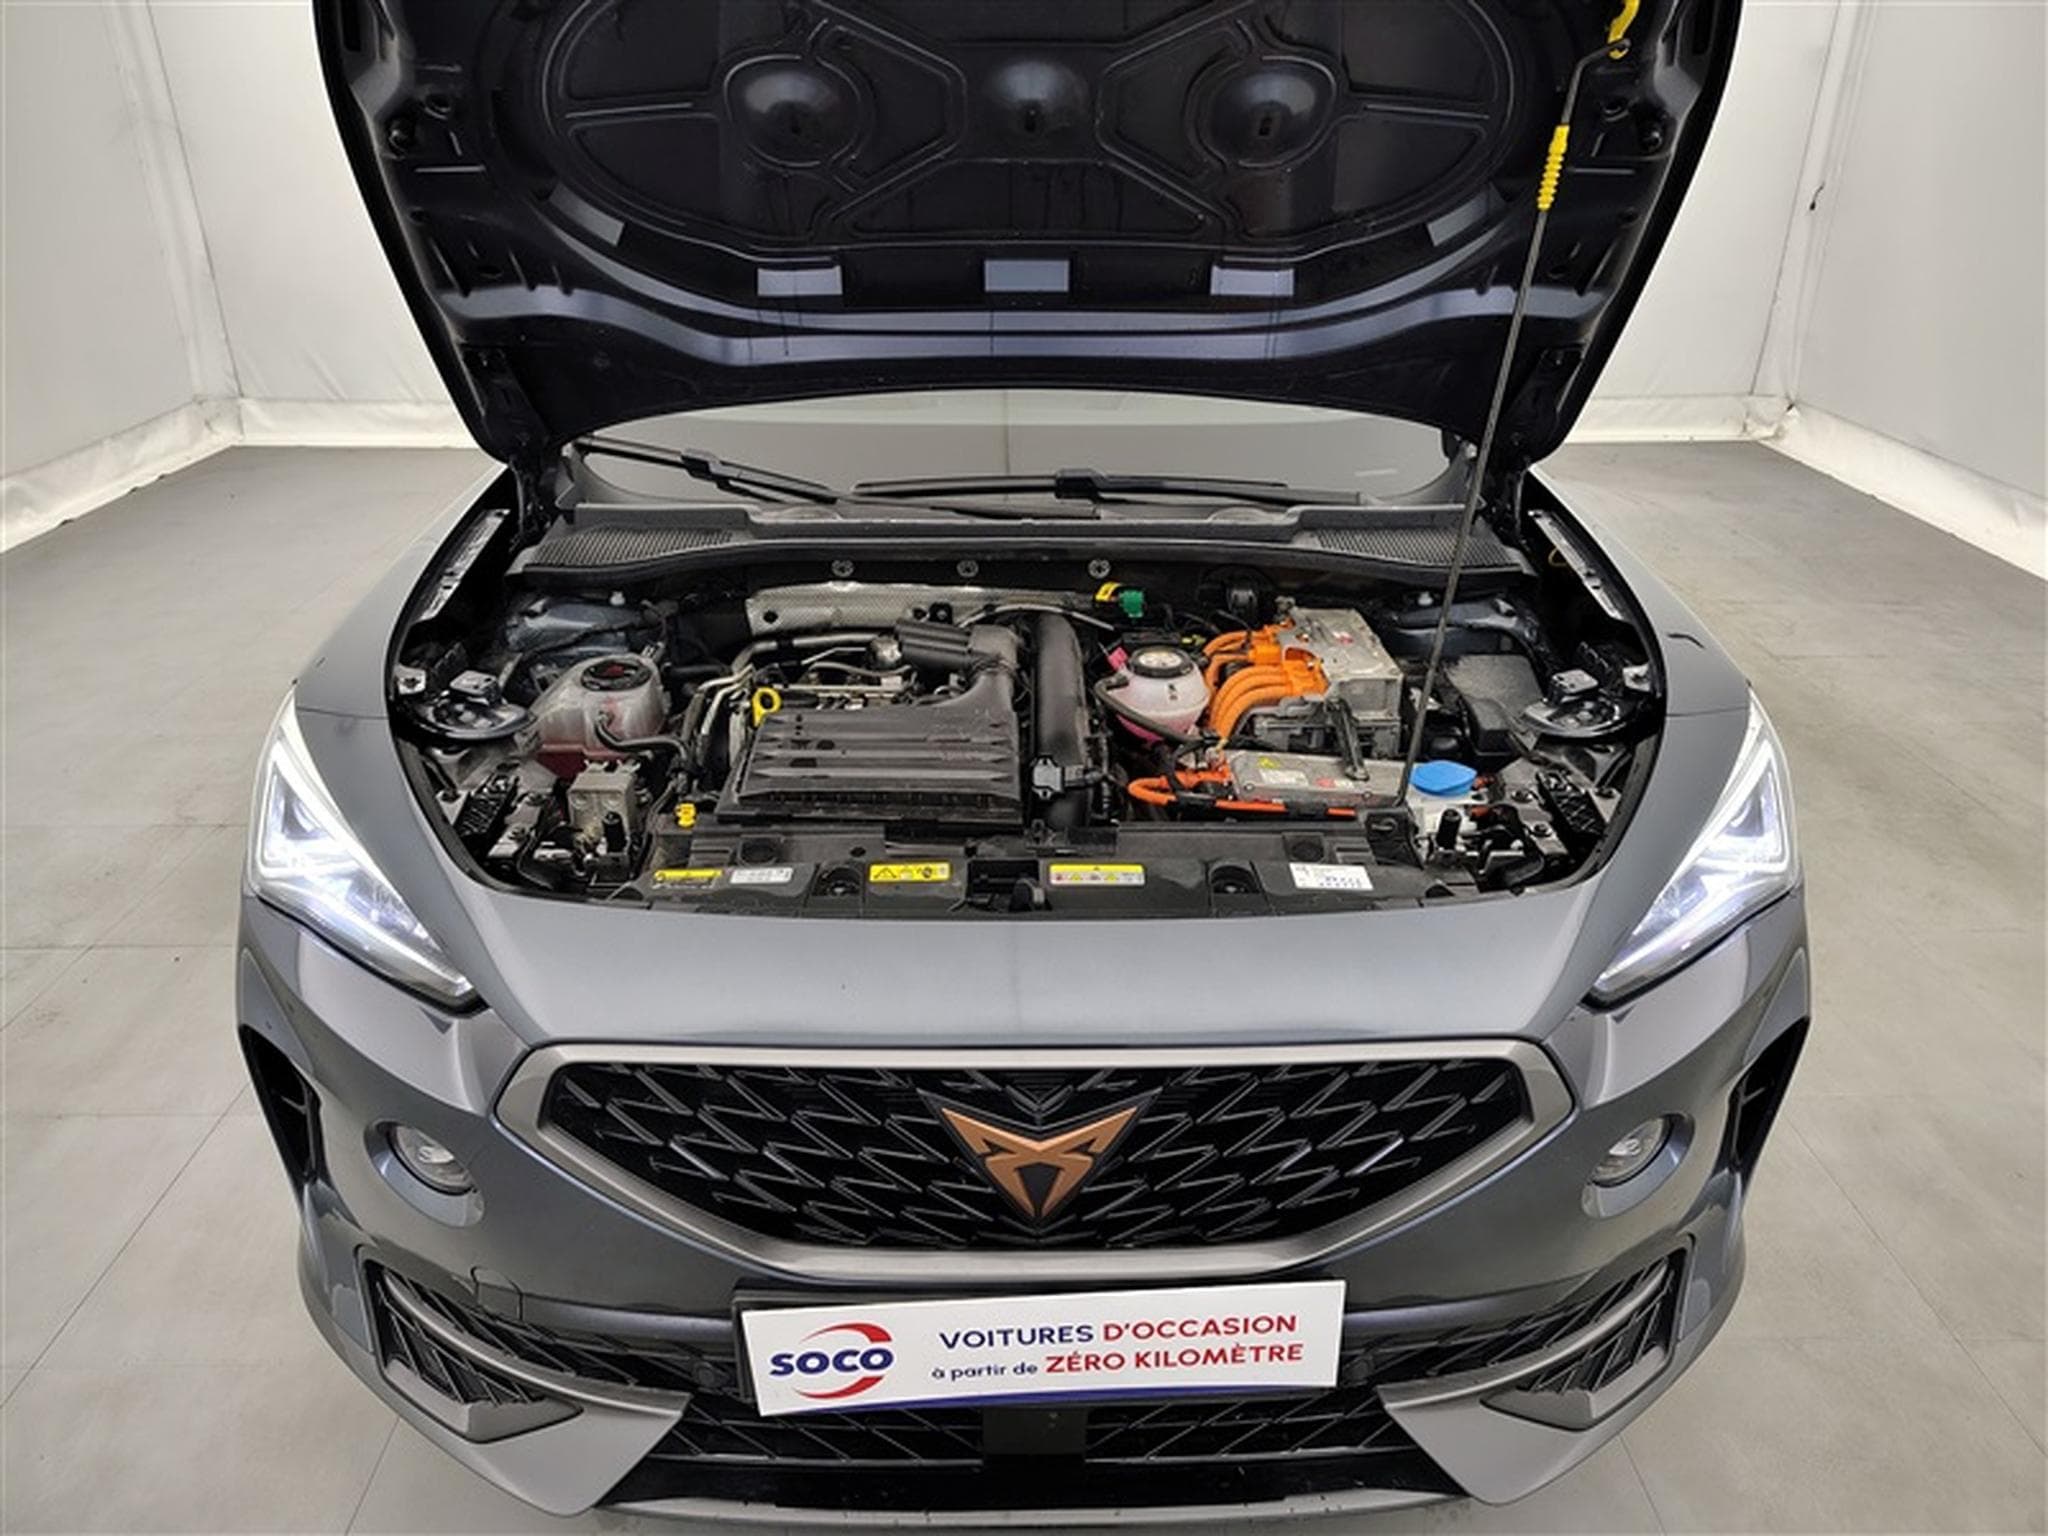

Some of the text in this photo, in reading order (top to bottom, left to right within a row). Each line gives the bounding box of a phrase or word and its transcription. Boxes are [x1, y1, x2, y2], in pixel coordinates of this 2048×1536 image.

[939, 1315, 1297, 1349] VOITURES D'OCCASION
[769, 1347, 894, 1377] SOCO
[931, 1343, 1304, 1381] à partir de ZÉRO KILOMÈTRE
